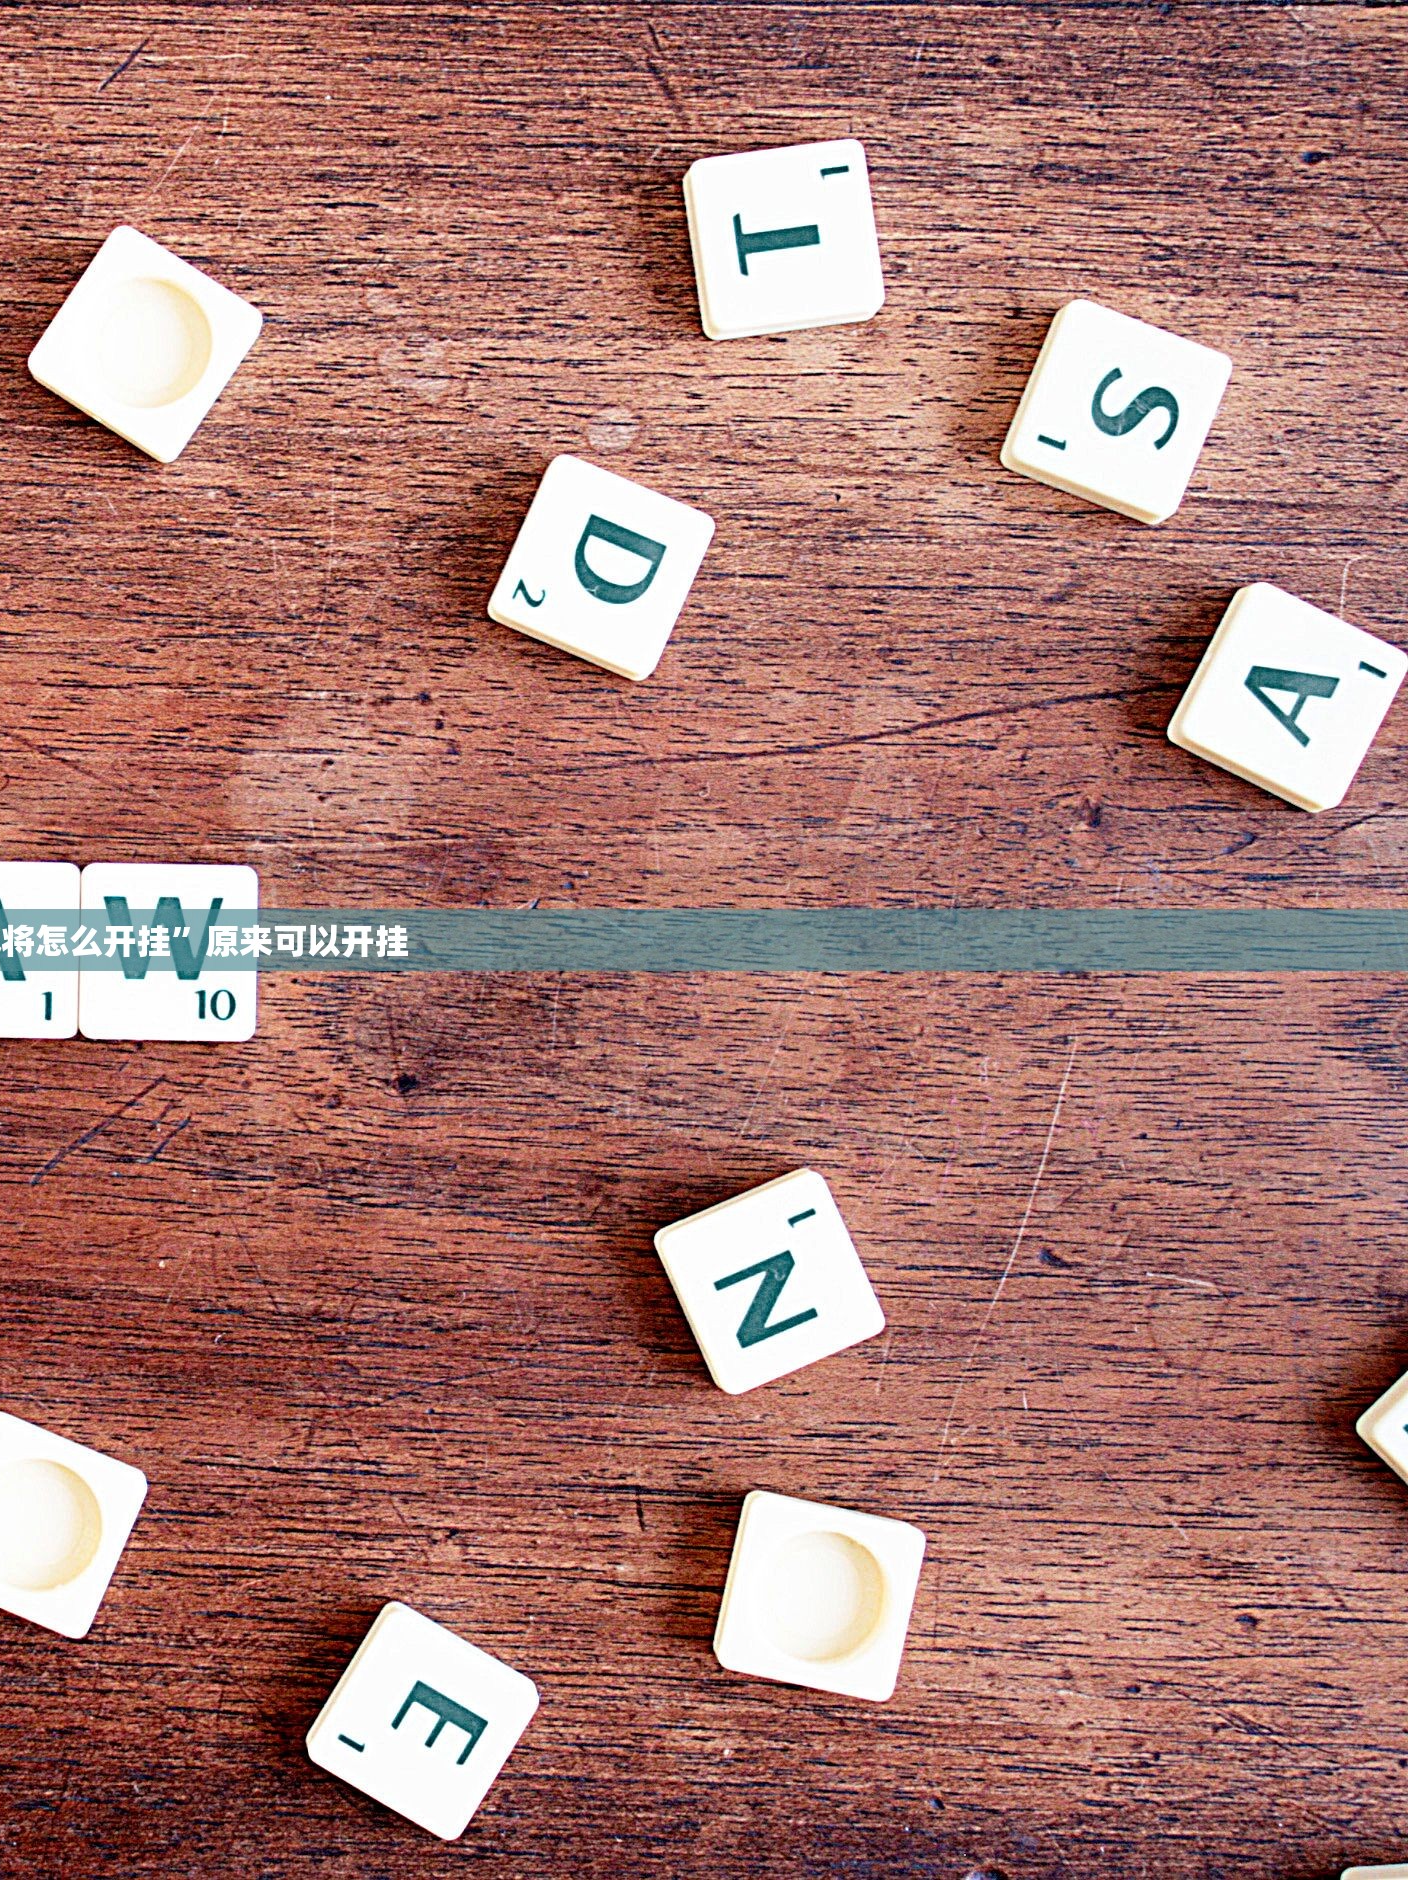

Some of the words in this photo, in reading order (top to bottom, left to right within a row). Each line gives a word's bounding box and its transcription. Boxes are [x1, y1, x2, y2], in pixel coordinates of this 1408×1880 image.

[820, 166, 851, 178] 1
[733, 214, 822, 277] T
[1092, 368, 1181, 451] S
[1038, 435, 1068, 452] 1
[575, 514, 668, 606] D
[513, 579, 547, 609] 2
[1359, 661, 1388, 680] 1
[1245, 666, 1341, 749] A
[40, 990, 54, 1022] 1
[193, 989, 238, 1022] 10
[788, 1209, 818, 1228] 1
[714, 1250, 819, 1350] N
[392, 1681, 490, 1767] E
[338, 1734, 366, 1754] 1
